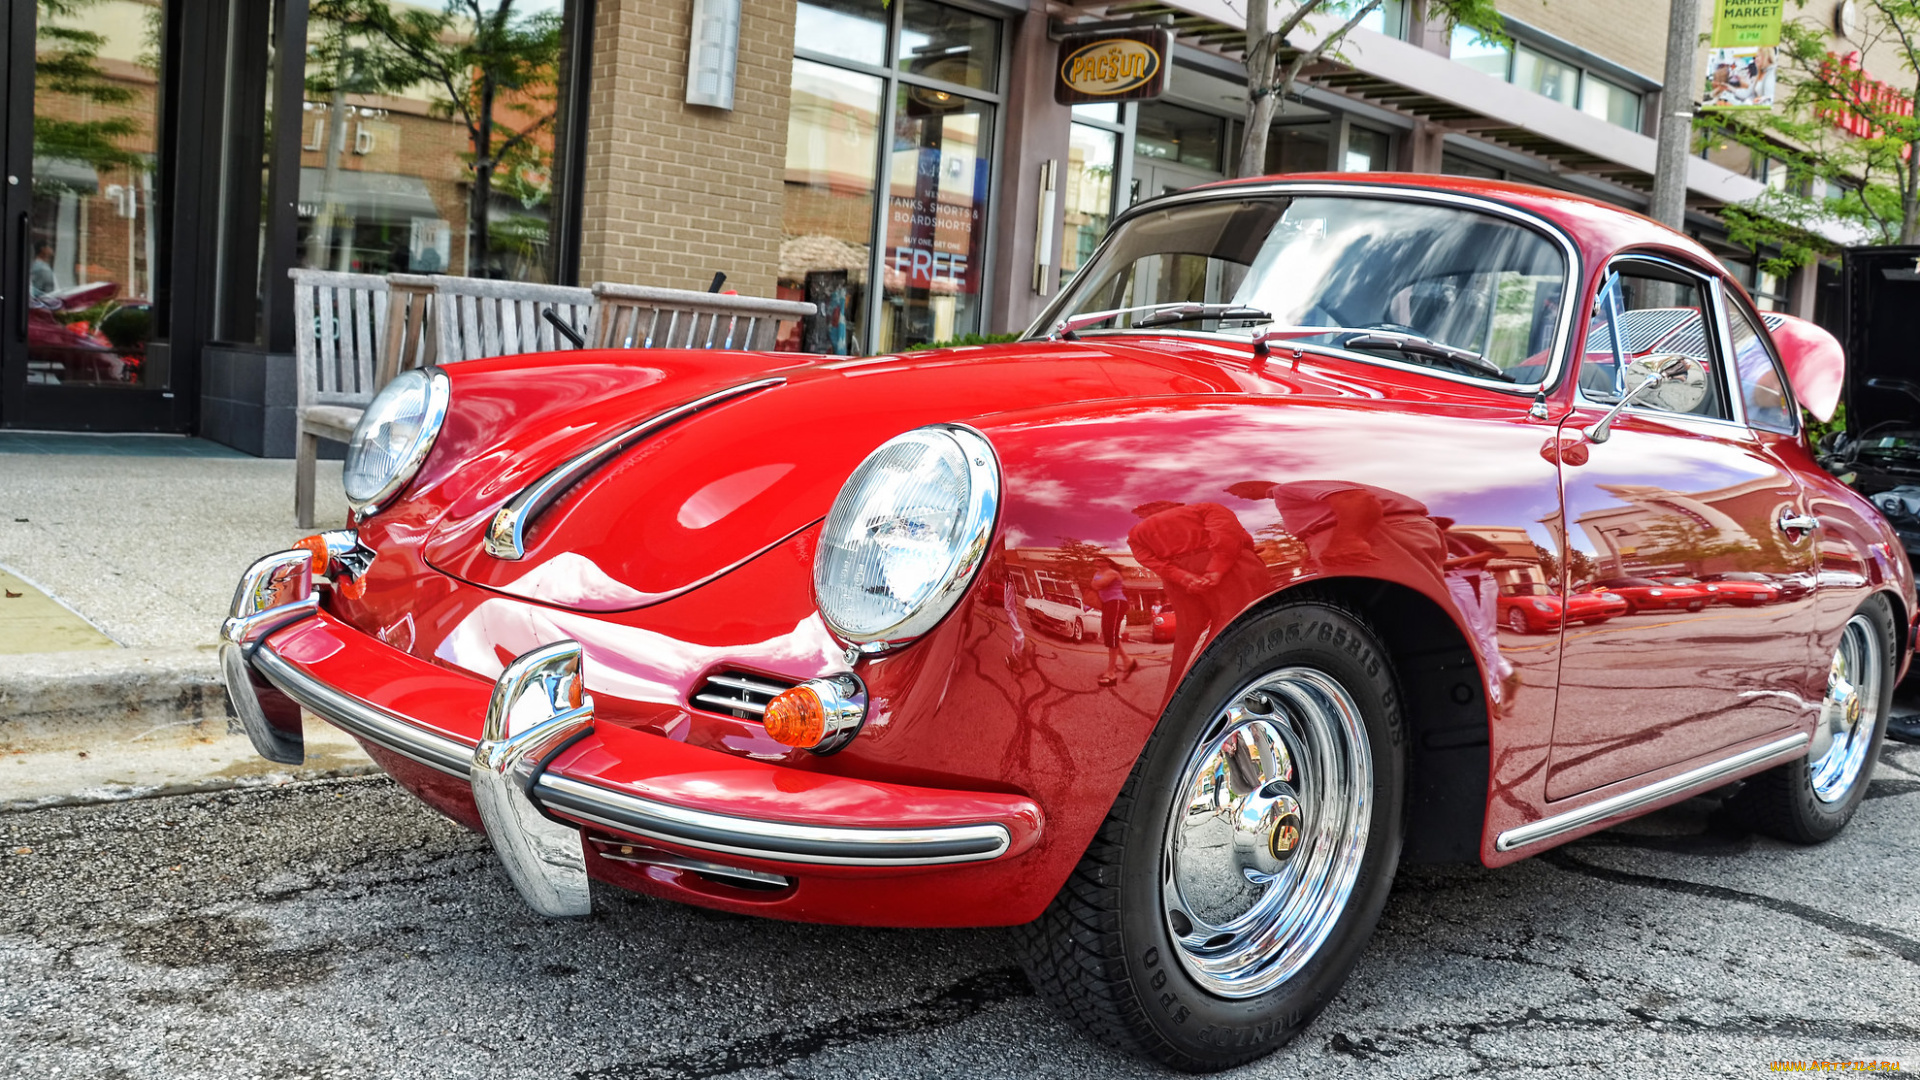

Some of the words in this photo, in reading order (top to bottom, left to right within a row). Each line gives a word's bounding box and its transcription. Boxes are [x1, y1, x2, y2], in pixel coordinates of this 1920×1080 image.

[1724, 6, 1779, 18] MARKET
[889, 197, 927, 212] TANKS,
[929, 202, 971, 219] SHORTS
[972, 209, 979, 220] &
[894, 211, 972, 233] BOARDSHORTS
[903, 236, 917, 246] BUY
[934, 240, 946, 250] GET
[947, 241, 961, 251] ONE
[894, 246, 968, 286] FREE
[1143, 945, 1192, 1026] SP60
[1198, 1009, 1303, 1047] DUNLOP
